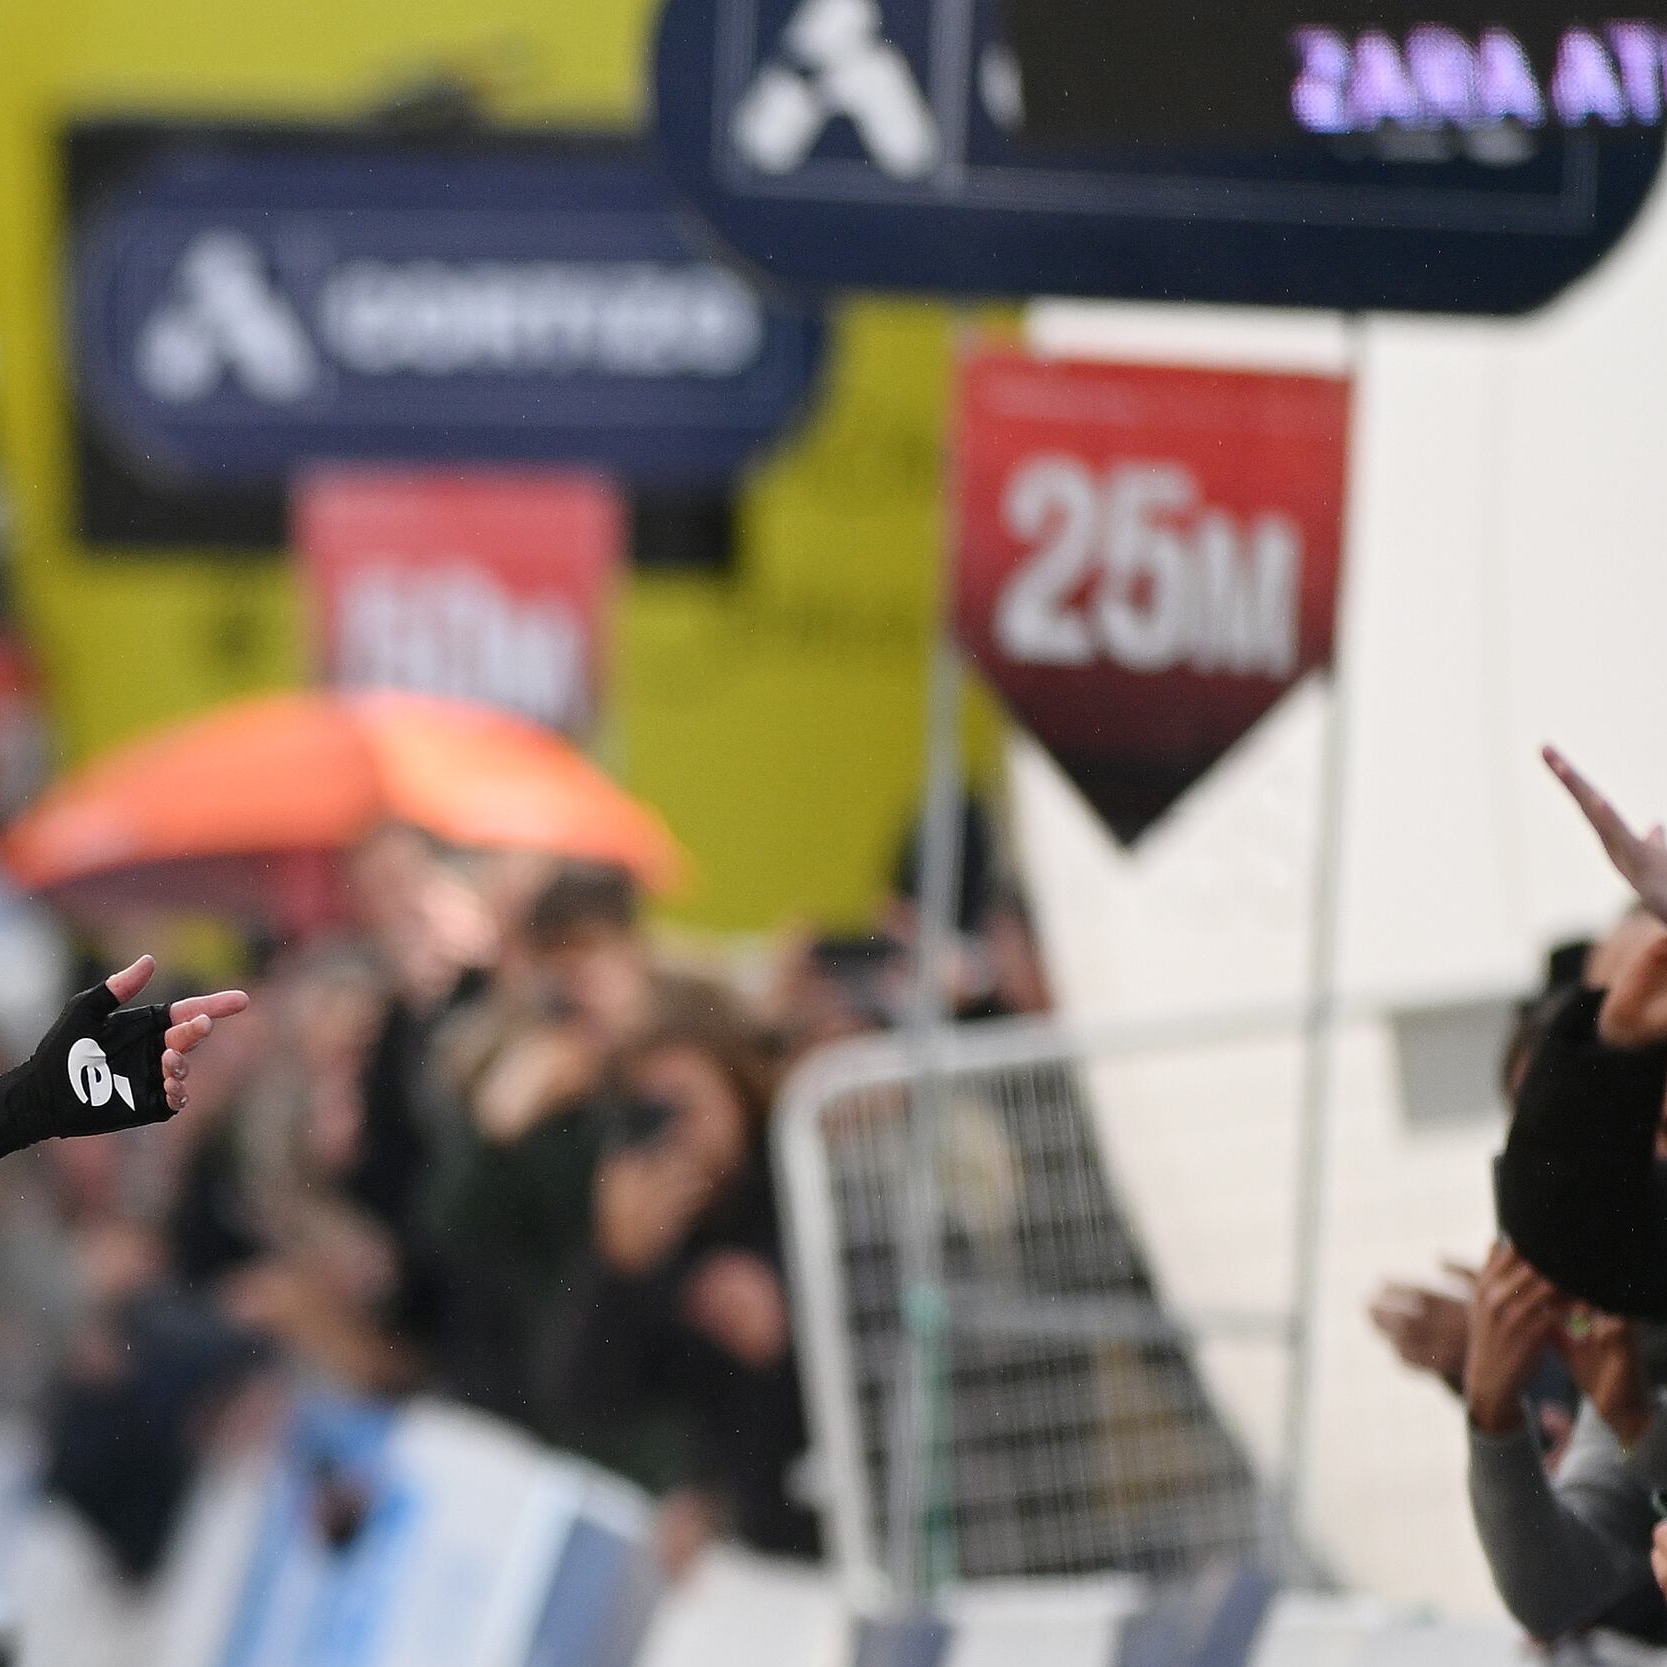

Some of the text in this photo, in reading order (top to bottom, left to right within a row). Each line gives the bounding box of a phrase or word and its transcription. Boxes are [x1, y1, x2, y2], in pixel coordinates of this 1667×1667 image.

[1289, 18, 1667, 132] ZARA AT
[994, 453, 1303, 679] 25M
